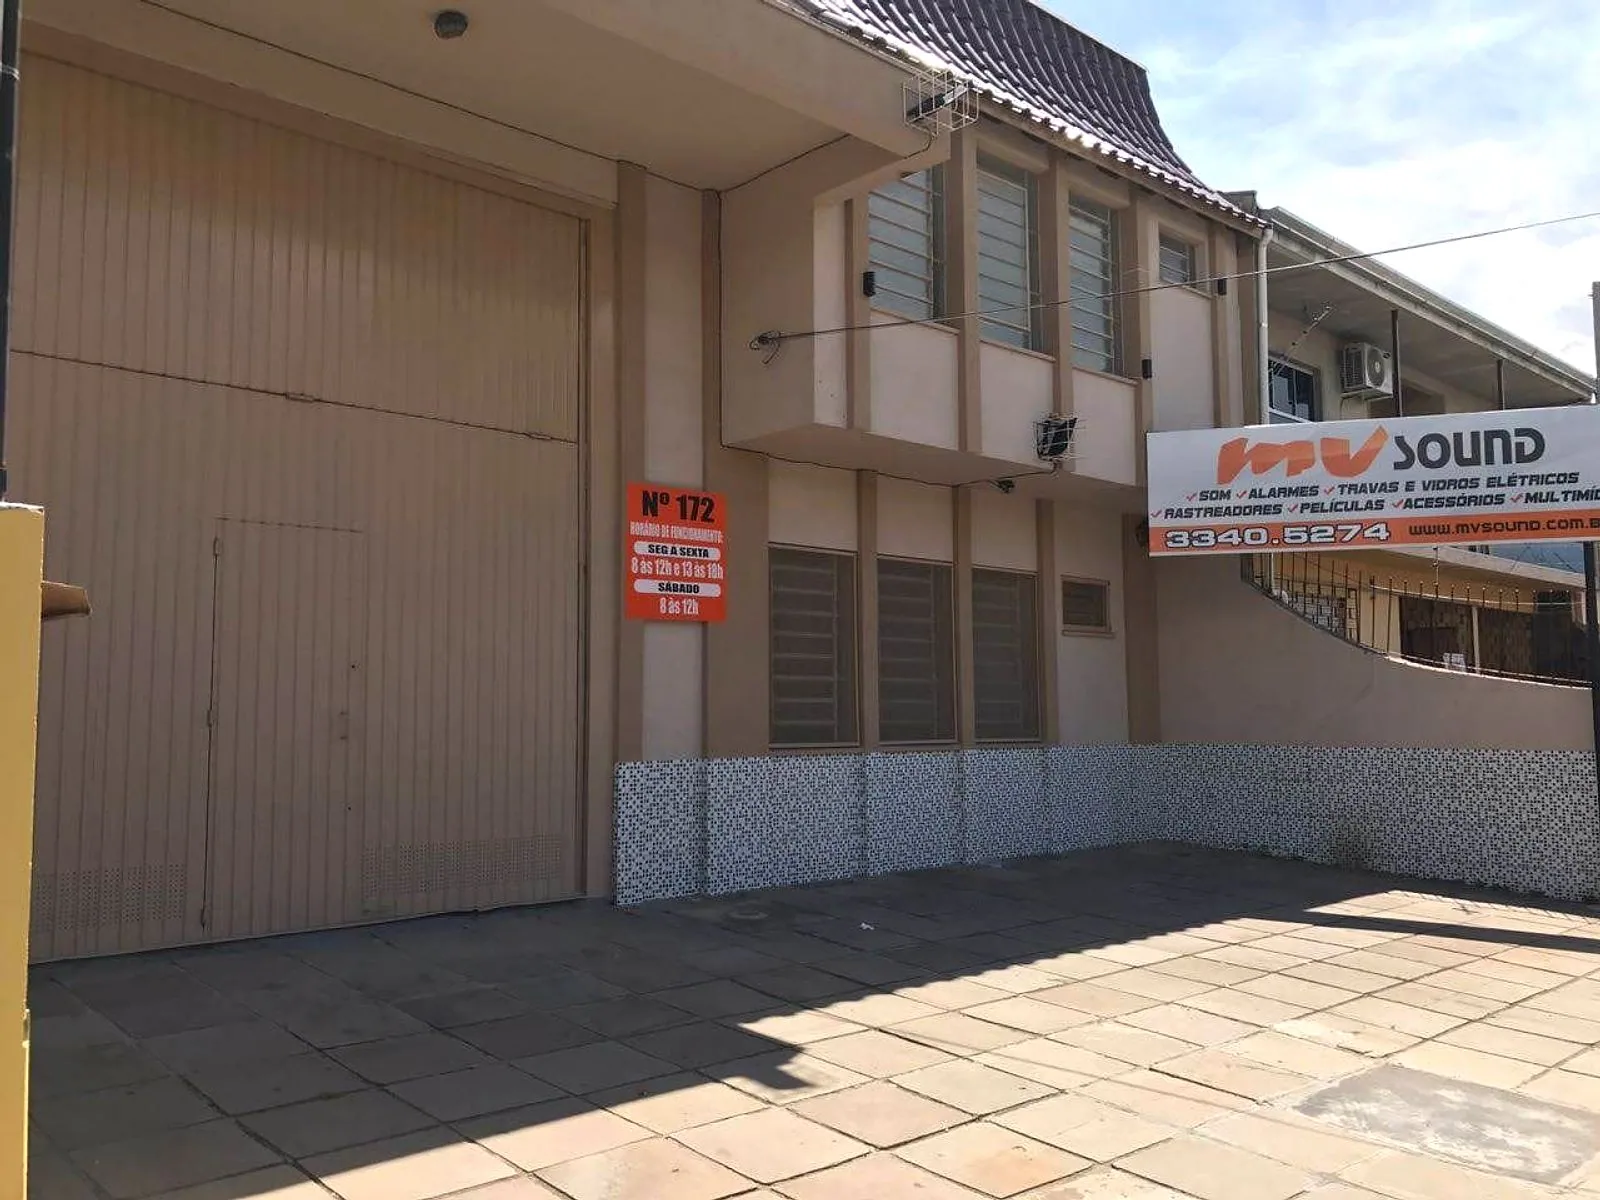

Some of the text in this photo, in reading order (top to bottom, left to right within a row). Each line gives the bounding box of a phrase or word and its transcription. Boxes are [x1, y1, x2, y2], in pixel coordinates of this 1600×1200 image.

[1393, 427, 1546, 470] SOUND
[1199, 472, 1580, 501] SOM ALARMES TRAVAS E VIDROS ELÉTRICOS
[675, 494, 715, 523] 172
[1164, 503, 1282, 519] RASTREADORES
[1300, 498, 1385, 514] PELÍCULAS
[1403, 493, 1506, 510] ACESSÓRIOS
[1165, 520, 1391, 550] 3340.5274
[648, 543, 709, 558] SEG A SEXTA
[631, 557, 638, 574] 8
[655, 559, 672, 576] 12h
[673, 563, 680, 576] e
[682, 561, 693, 577] 13
[659, 597, 667, 614] 8
[682, 598, 699, 615] 12h
